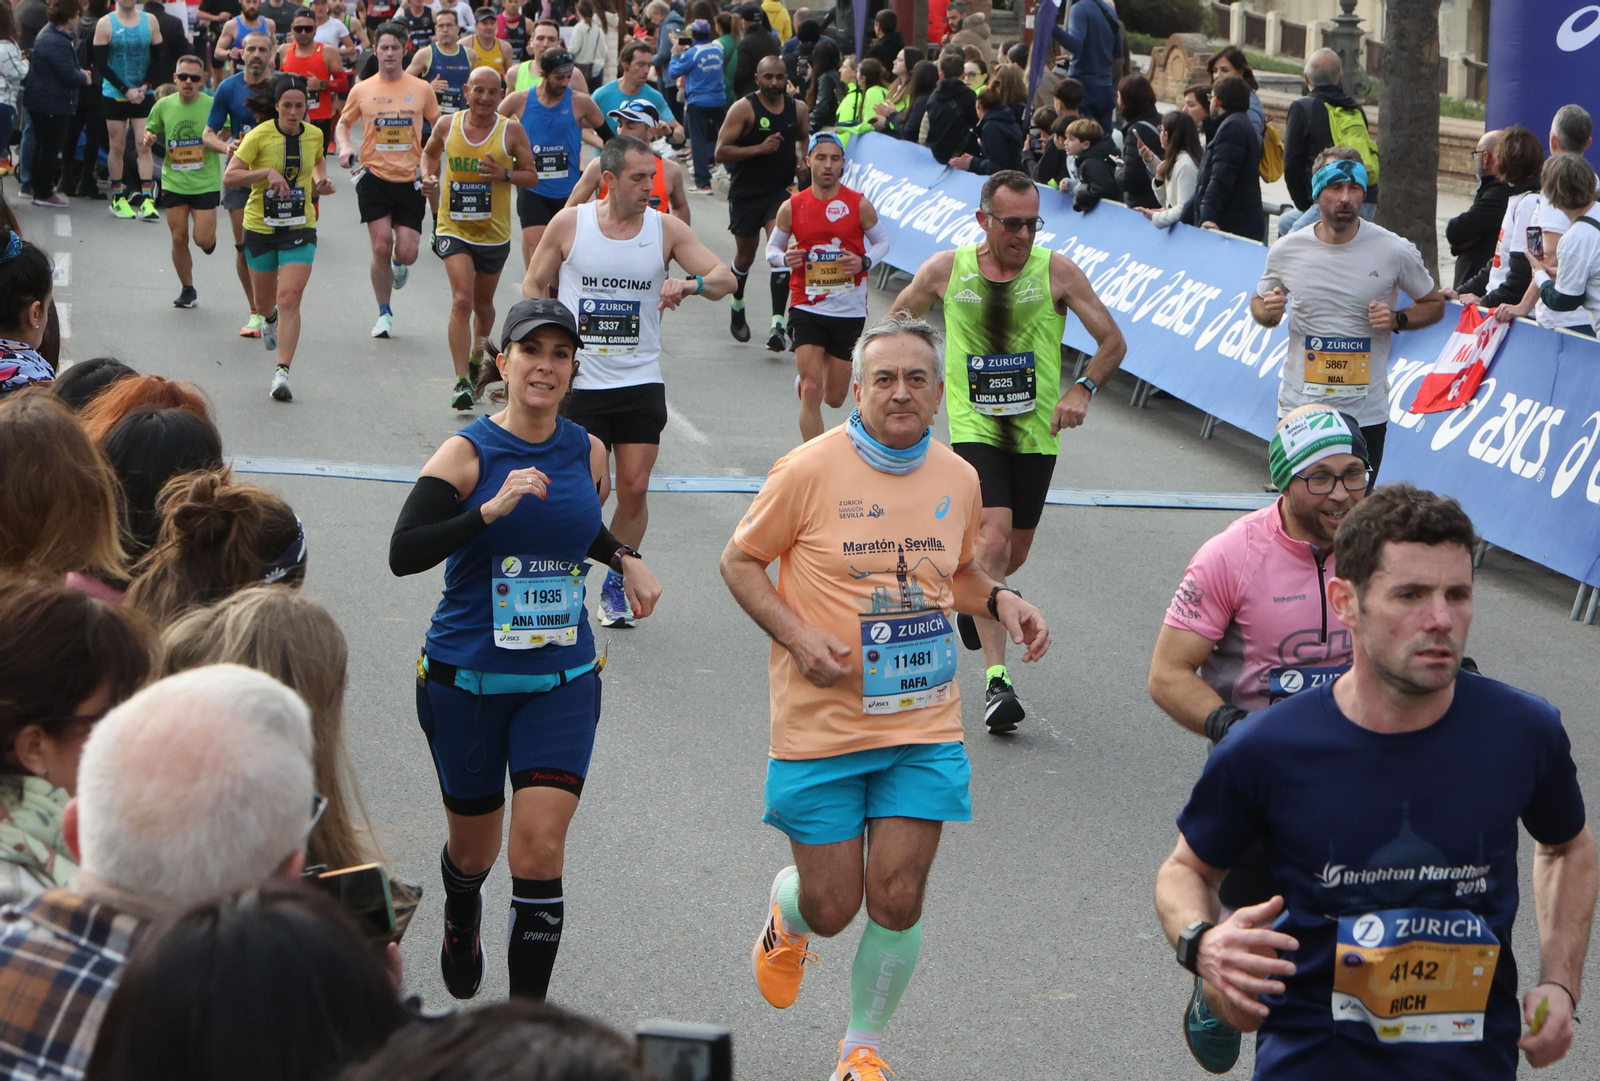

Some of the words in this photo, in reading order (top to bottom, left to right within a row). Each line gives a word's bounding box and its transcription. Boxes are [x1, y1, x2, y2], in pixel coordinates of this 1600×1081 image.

[277, 202, 293, 210] 2420
[821, 267, 838, 275] 5332
[582, 276, 598, 287] DH
[601, 277, 652, 291] COCINAS
[599, 303, 633, 311] ZURICH
[598, 321, 620, 331] 3337
[608, 336, 639, 344] GAYANGO
[1326, 341, 1363, 350] ZURICH
[988, 356, 1027, 368] ZURICH
[1325, 360, 1348, 370] 5867
[1099, 260, 1164, 313] asics
[1151, 278, 1222, 336] asics
[1468, 391, 1566, 479] asics
[989, 378, 1013, 389] 2525
[1328, 376, 1345, 384] NIAL
[975, 393, 997, 403] LUCIA
[998, 394, 1005, 402] &
[1006, 391, 1030, 401] SONIA
[839, 499, 863, 507] ZURICH
[838, 512, 865, 520] SEVILLA
[839, 506, 864, 514] MARATÓN
[843, 538, 895, 553] Maratón
[528, 560, 578, 573] ZURICH
[524, 589, 562, 604] 11935
[512, 615, 534, 627] ANA
[898, 618, 945, 637] ZURICH
[894, 650, 931, 669] 11481
[900, 676, 928, 690] RAFA
[1344, 868, 1415, 885] Brighton
[1418, 863, 1491, 881] Marathon
[1455, 879, 1487, 897] 2019
[1395, 917, 1482, 938] ZURICH
[1389, 960, 1439, 983] 4142
[1389, 994, 1427, 1014] RICH
